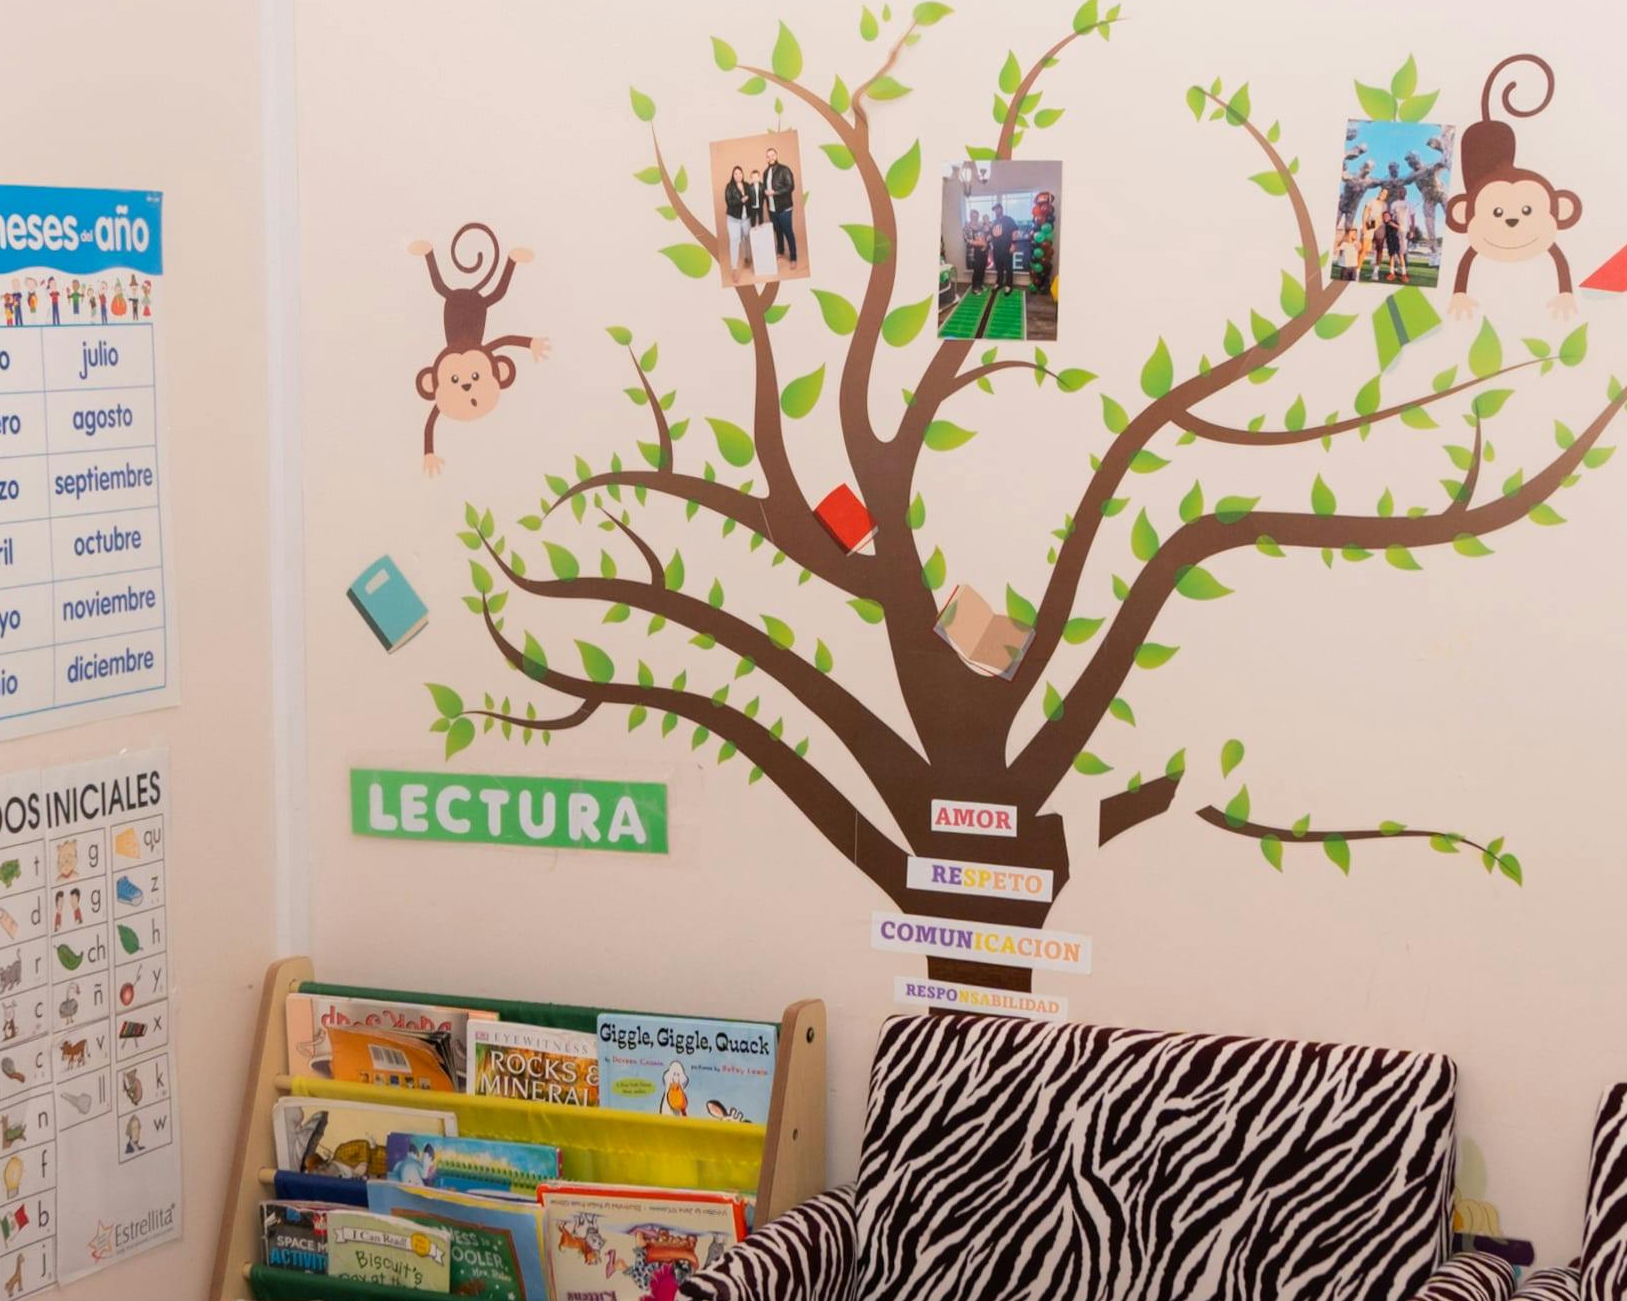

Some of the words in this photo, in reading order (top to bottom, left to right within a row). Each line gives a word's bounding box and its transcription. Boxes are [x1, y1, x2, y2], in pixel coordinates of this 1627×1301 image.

[80, 230, 93, 243] del
[94, 205, 150, 252] año
[79, 340, 119, 380] julio
[73, 403, 133, 436] agosto
[55, 462, 153, 500] septiembre
[74, 525, 142, 557] octubre
[63, 585, 156, 621] noviembre
[67, 647, 154, 683] diciembre
[46, 770, 161, 829] INICIALES
[369, 783, 647, 844] LECTURA
[934, 807, 1012, 829] AMOR
[143, 828, 161, 852] qu
[33, 855, 40, 877] t
[88, 843, 99, 868] g
[150, 875, 159, 893] z
[931, 864, 1043, 894] RESPETO
[30, 895, 42, 925] d
[91, 888, 102, 914] g
[151, 918, 161, 945] h
[880, 920, 1081, 962] COMUNICACION
[87, 934, 106, 963] ch
[34, 956, 42, 975] r
[152, 968, 161, 993] y
[94, 984, 103, 1006] ñ
[906, 983, 1060, 1014] RESPONSABILIDAD
[34, 1001, 43, 1018] c
[153, 1015, 162, 1031] x
[96, 1035, 105, 1049] v
[494, 1033, 589, 1054] EYEWITNESS
[600, 1023, 653, 1049] Giggle,
[656, 1027, 712, 1055] Giggle,
[715, 1032, 770, 1055] Quack
[35, 1051, 44, 1069] c
[490, 1050, 577, 1083] ROCKS
[155, 1062, 164, 1089] k
[37, 1110, 48, 1129] n
[152, 1114, 166, 1131] w
[41, 1149, 48, 1178] f
[38, 1200, 50, 1228] b
[115, 1207, 173, 1247] Estrellita
[276, 1235, 314, 1251] SPACE
[356, 1250, 423, 1285] Biscuit's
